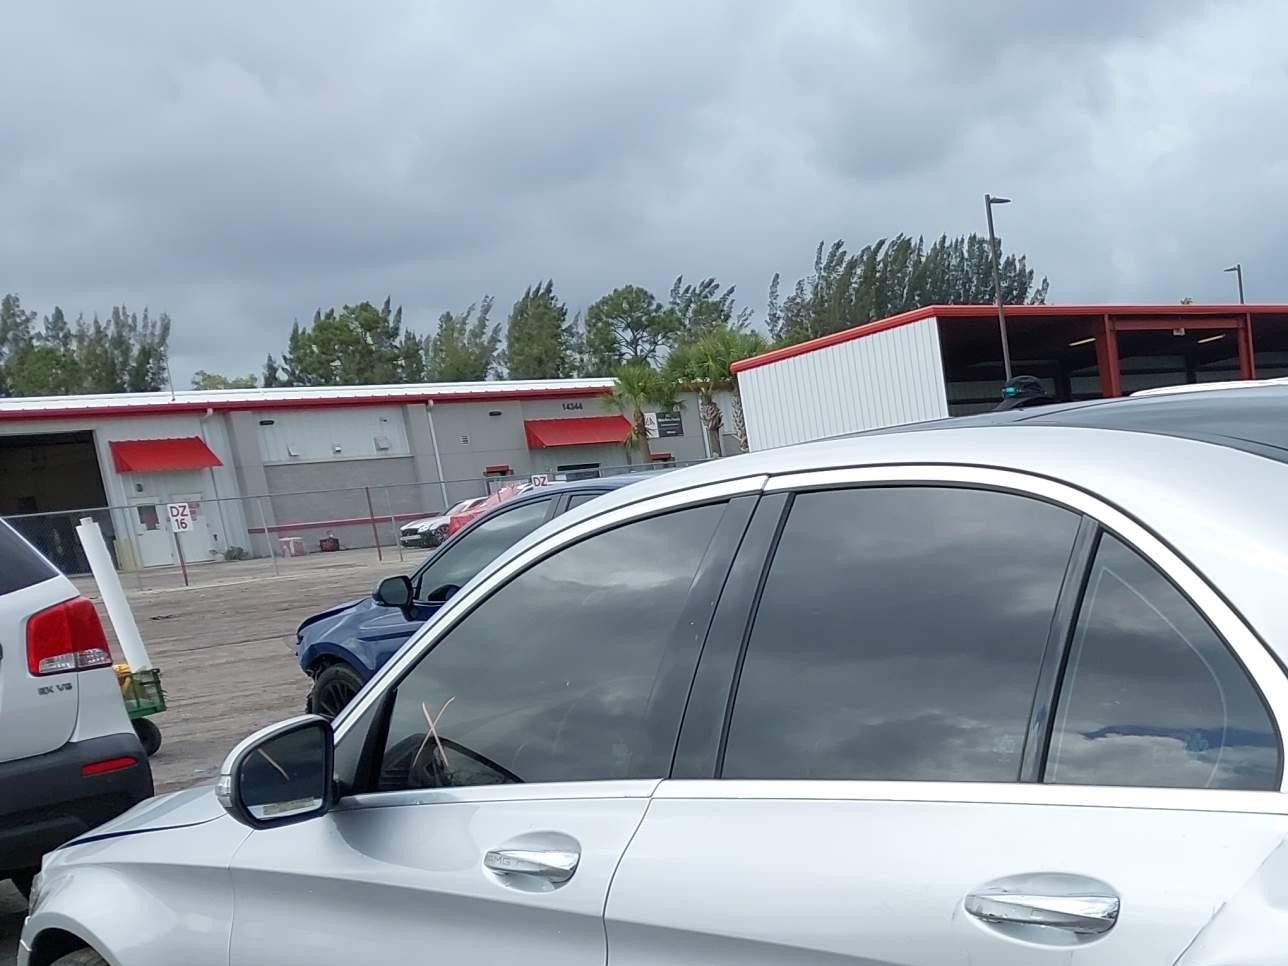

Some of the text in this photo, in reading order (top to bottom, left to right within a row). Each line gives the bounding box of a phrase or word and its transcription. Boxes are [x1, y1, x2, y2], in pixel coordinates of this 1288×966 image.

[533, 476, 547, 487] DZ
[170, 505, 189, 517] DZ
[175, 518, 188, 529] 16
